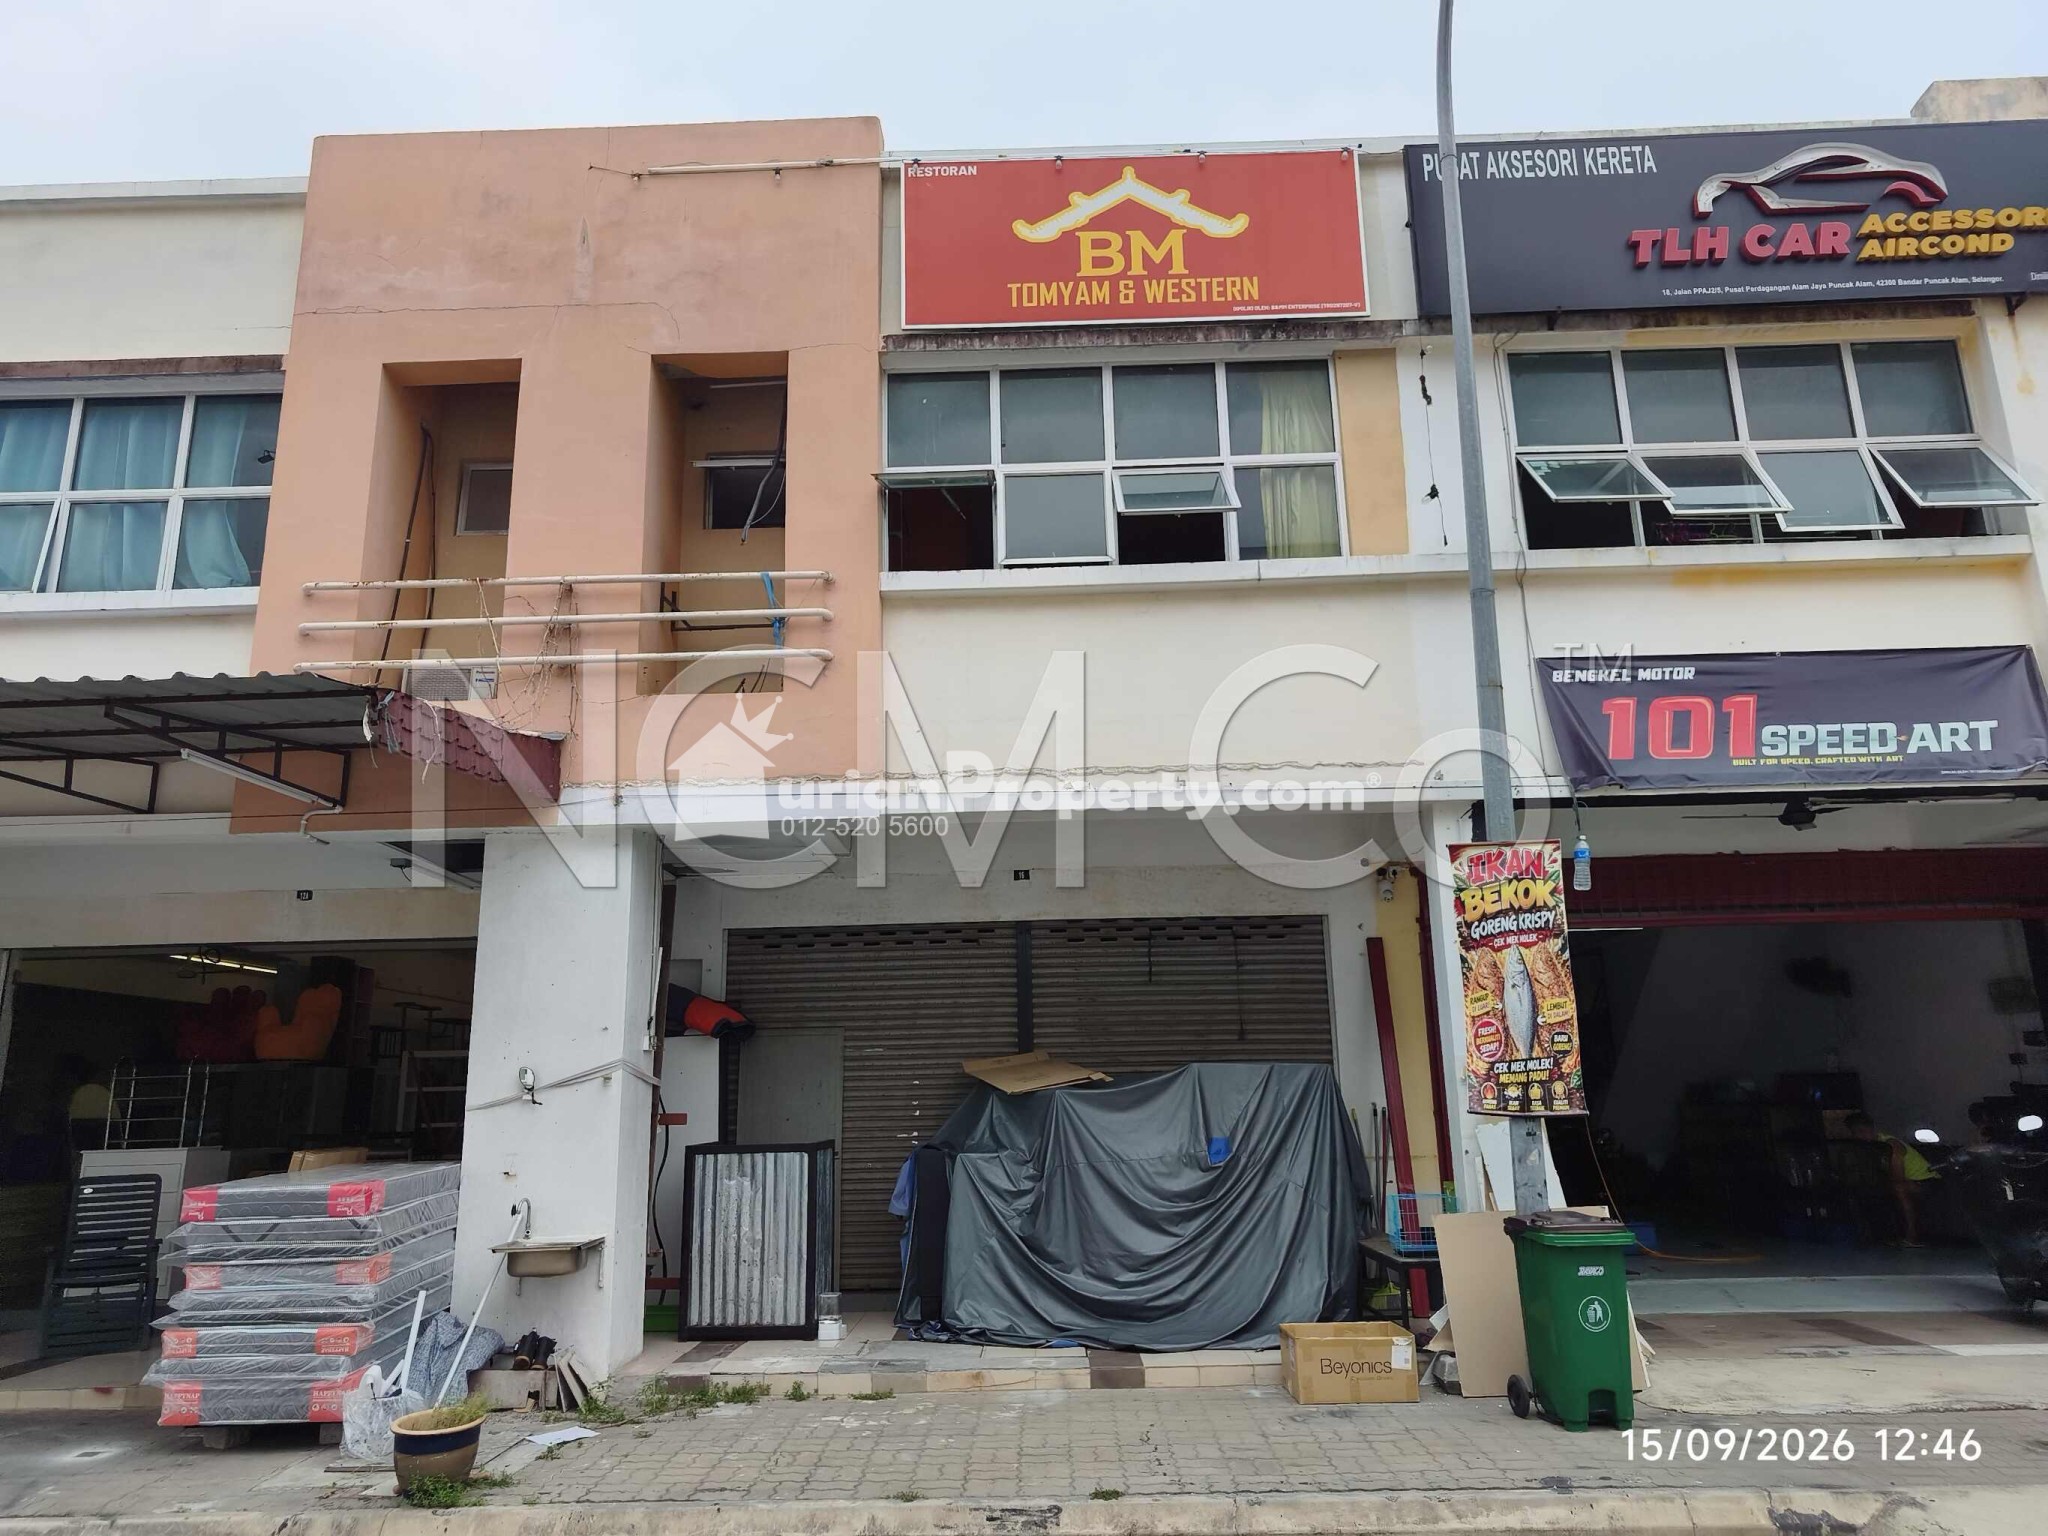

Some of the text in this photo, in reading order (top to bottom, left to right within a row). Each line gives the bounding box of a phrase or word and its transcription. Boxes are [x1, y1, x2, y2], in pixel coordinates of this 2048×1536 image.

[907, 165, 977, 177] RESTORAN
[1487, 148, 1579, 180] AKSESORI
[1583, 145, 1657, 176] KERETA
[1075, 229, 1189, 277] BM
[1629, 221, 1852, 266] TLH CAR
[1856, 233, 2015, 262] AIRCOND
[1007, 276, 1260, 307] TOMYAM & WESTERN
[1674, 288, 1693, 296] Jalan
[1725, 286, 1745, 294] Pusat
[1745, 283, 1791, 294] Perdagangan
[1791, 283, 1811, 291] Alam
[1811, 282, 1827, 291] Jaya
[1828, 281, 1854, 290] Puncak
[1855, 280, 1875, 289] Alam,
[1897, 277, 1923, 286] Bandar
[1924, 276, 1950, 285] Puncak
[1951, 275, 1971, 285] Alam,
[1552, 666, 1696, 683] BENGKEL MOTOR
[1601, 693, 1999, 761] 101 SPEED ART
[1732, 758, 1757, 766] BUILT
[1760, 758, 1778, 766] FOR
[1815, 756, 1857, 765] CRAFTED
[1858, 755, 1883, 763] WITH
[1886, 754, 1904, 763] ART
[1468, 848, 1545, 887] IKAN
[1459, 879, 1557, 922] BEKOK
[1471, 910, 1555, 940] GORENG KRISPY
[1506, 935, 1519, 945] MEK
[1546, 1001, 1568, 1012] LEMBUT
[1493, 1057, 1554, 1074] CEK MEK MOLEK!
[1498, 1069, 1549, 1084] MEMANG PADU!
[1320, 1357, 1393, 1379] Beyonics
